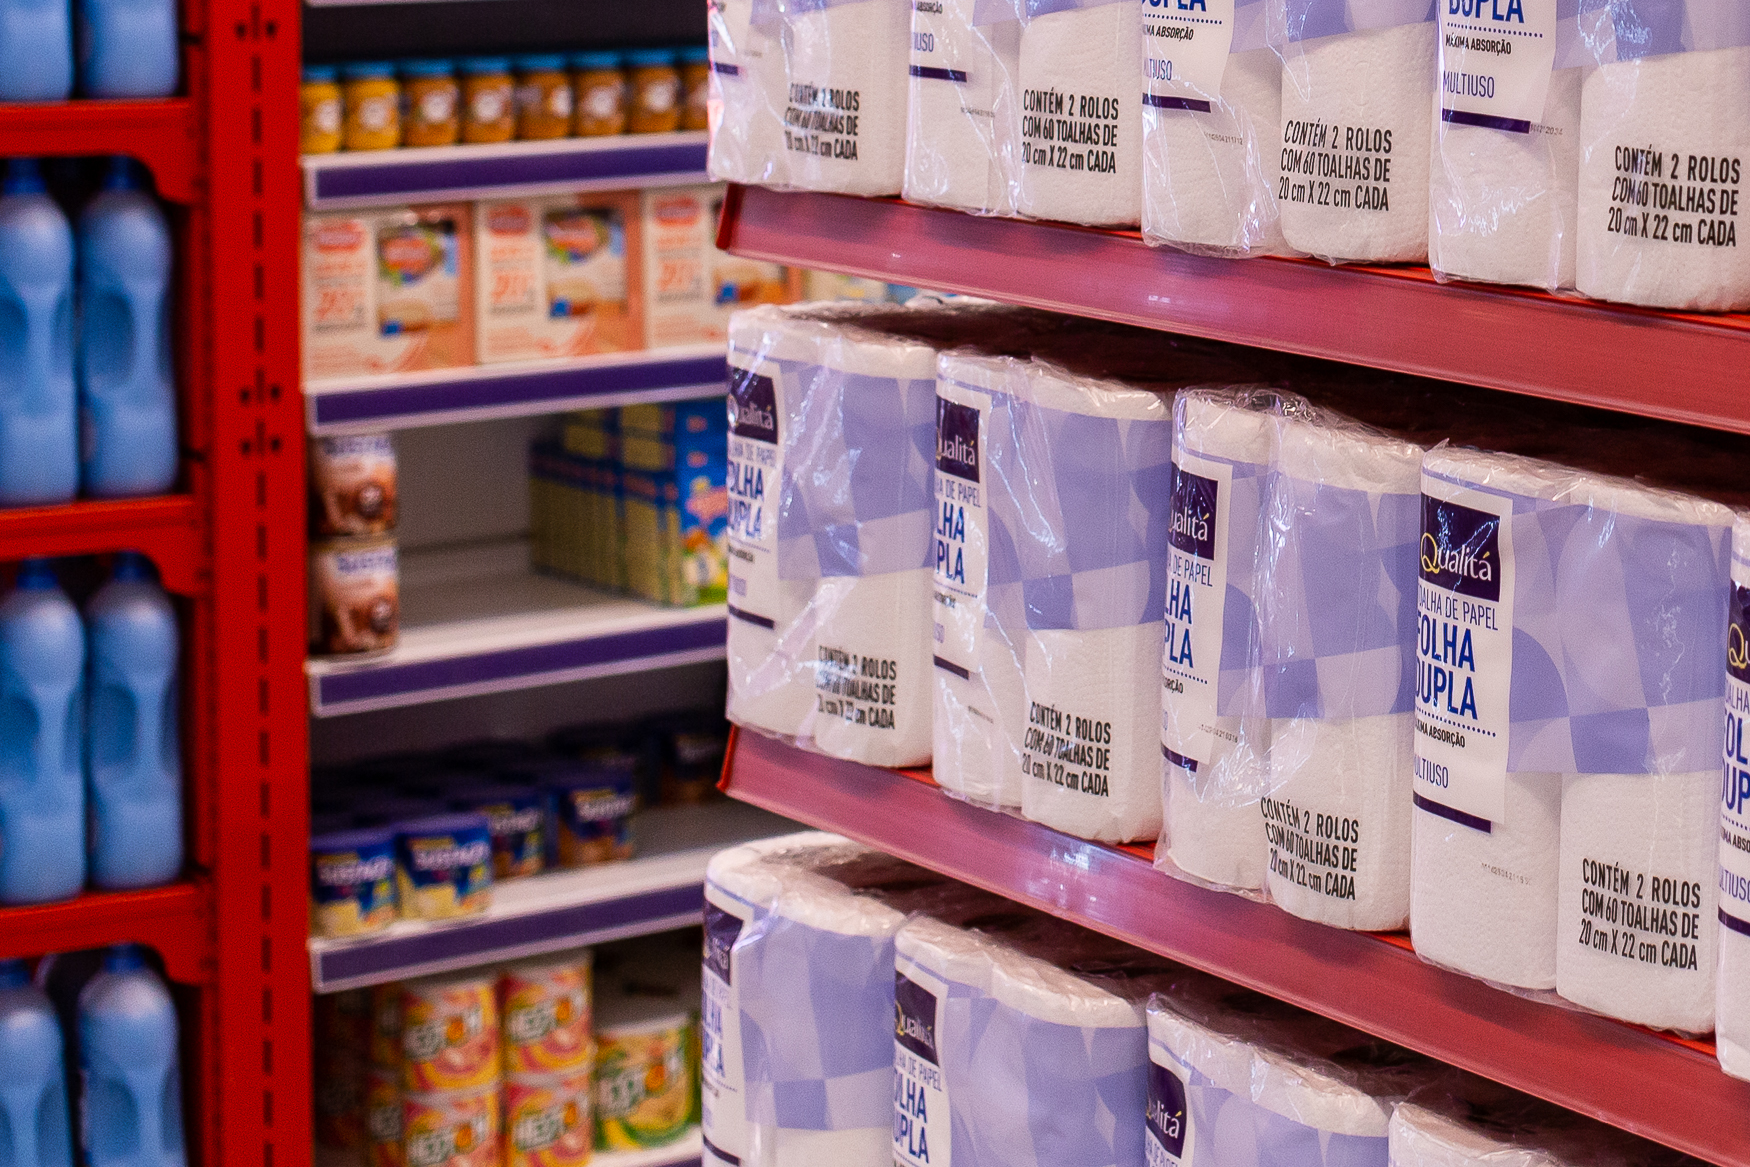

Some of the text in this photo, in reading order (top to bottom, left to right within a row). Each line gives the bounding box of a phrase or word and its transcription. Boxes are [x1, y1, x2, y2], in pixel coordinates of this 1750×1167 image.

[1471, 38, 1512, 56] ABSORÇÃO
[1442, 70, 1495, 98] MULTIUSO
[1615, 144, 1740, 184] CONTÉM 2 ROLOS
[1612, 176, 1739, 215] COM 60 TOALHAS DE
[1608, 207, 1736, 247] 20 cm X 22 cm CADA
[1420, 533, 1492, 581] Qualitá
[1446, 596, 1498, 631] DE PAPEL
[1429, 728, 1465, 748] ABSORÇÃO
[1583, 858, 1700, 908] CONTÉM 2 ROLOS
[1582, 888, 1699, 939] COM 60 TOALHAS DE
[1579, 918, 1697, 970] 20 cm X 22 cm CADA
